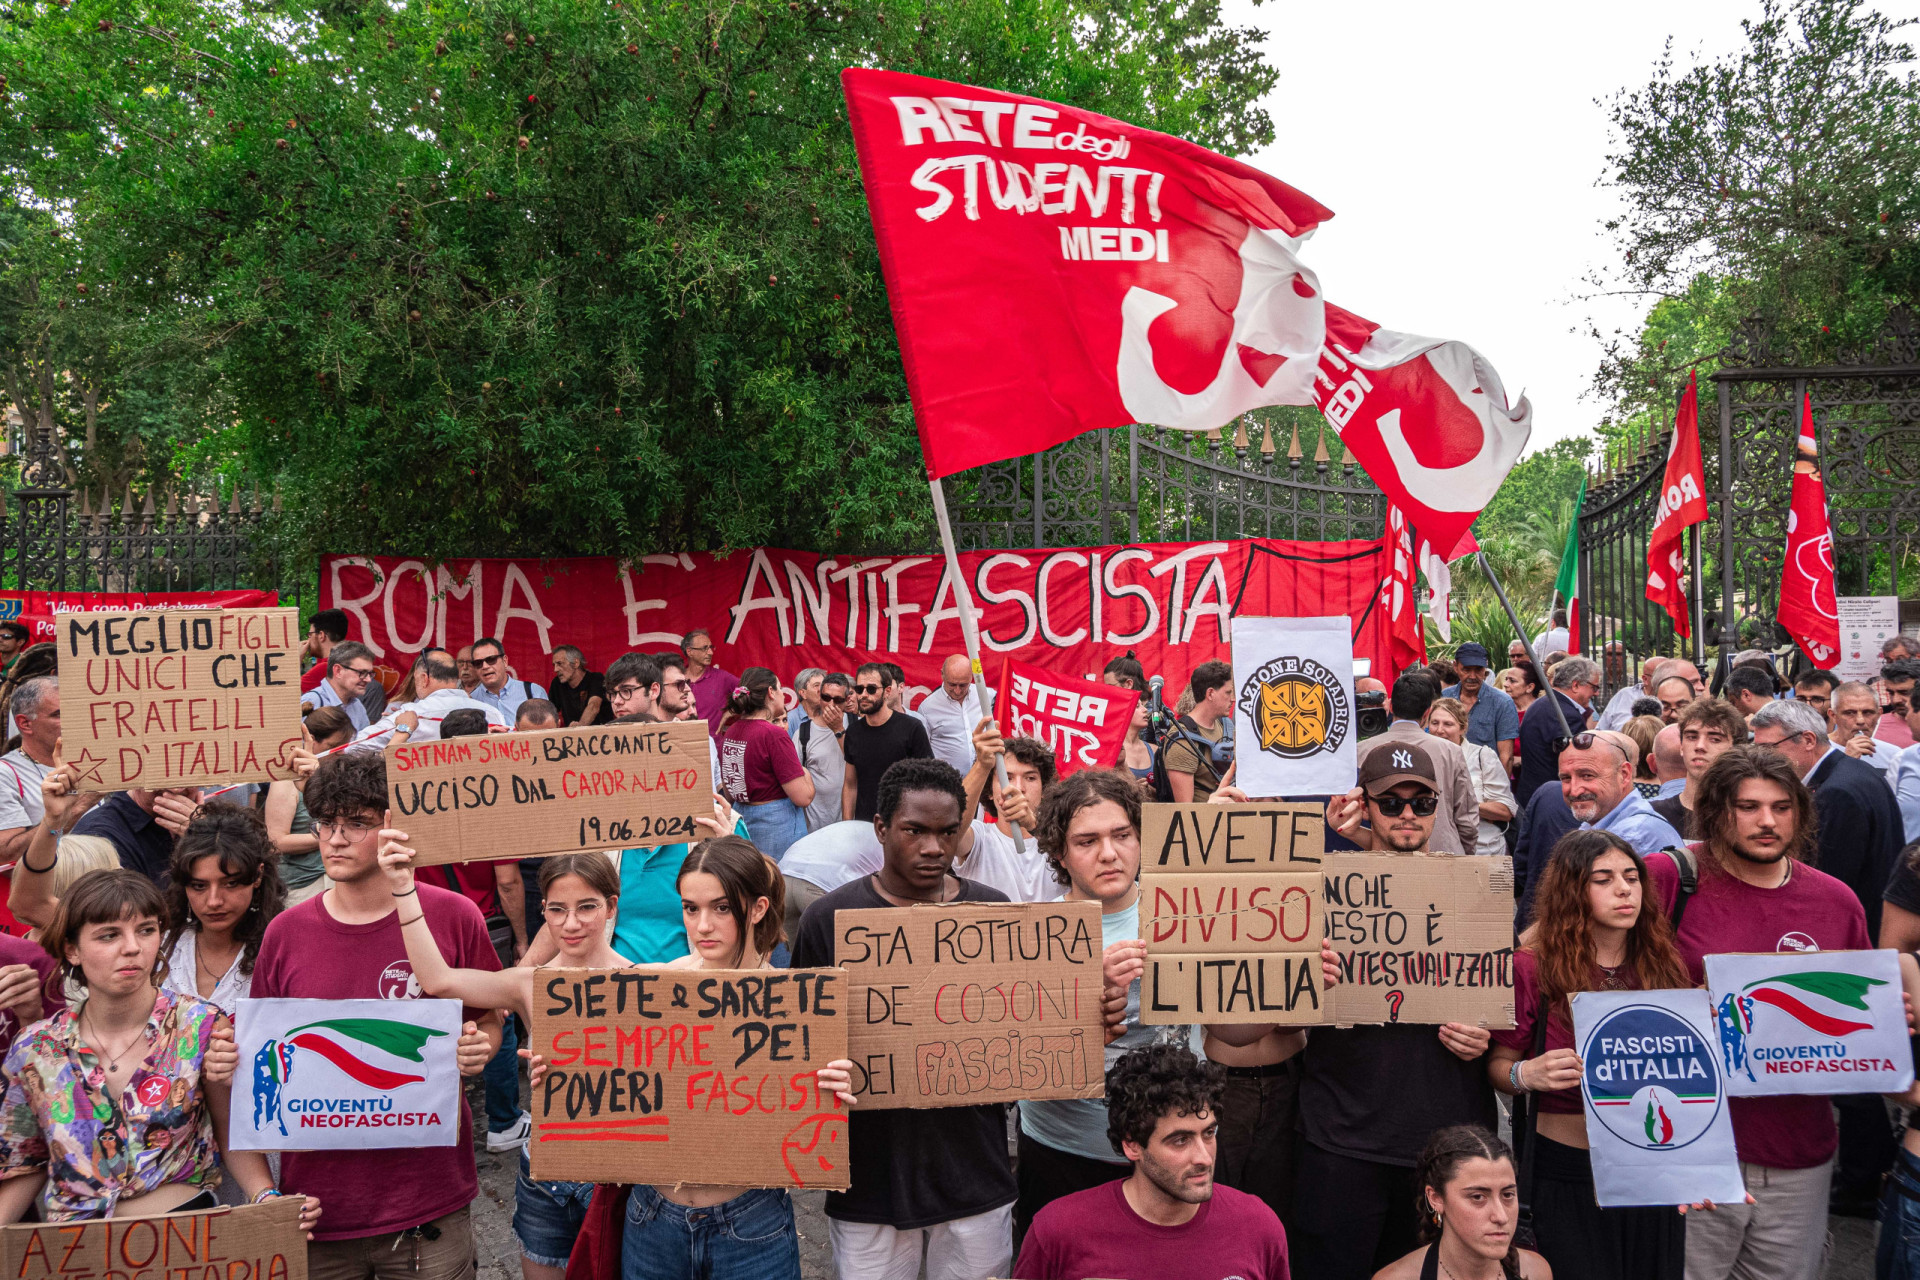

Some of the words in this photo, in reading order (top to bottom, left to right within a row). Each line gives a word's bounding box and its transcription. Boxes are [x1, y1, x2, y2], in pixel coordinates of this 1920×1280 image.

[889, 97, 1059, 148] RETE
[1053, 123, 1131, 160] degli
[910, 154, 1165, 225] STUDENTI
[1059, 226, 1169, 262] MEDI
[330, 557, 553, 658] ROMA
[725, 542, 1231, 653] ANTIFASCISTA
[69, 616, 213, 656] MEGLIO
[219, 615, 290, 650] FIGLI
[86, 655, 187, 695] UNICI
[212, 653, 286, 688] CHE
[89, 696, 265, 739] FRATELLI
[1240, 659, 1298, 715] AZIONE
[1303, 661, 1348, 752] SQUADRISTA
[120, 740, 261, 782] D'ITALIA
[395, 739, 472, 772] SATNAM
[480, 738, 538, 767] SINGH,
[543, 731, 672, 762] BRACCIANTE
[1392, 749, 1413, 768] NY
[513, 775, 555, 804] DAL
[562, 769, 698, 799] CAPORALATO
[579, 816, 697, 847] 19.06.2024
[1158, 811, 1323, 866] AVETE
[1322, 873, 1392, 908] NCHE
[1152, 886, 1311, 943] DIVISO
[1325, 910, 1407, 945] ESTO
[1426, 904, 1443, 946] È
[840, 926, 913, 968] STA
[934, 915, 1093, 965] ROTTURA
[546, 974, 662, 1020] SIETE
[698, 974, 837, 1019] SARETE
[866, 985, 913, 1025] DE
[936, 978, 1079, 1024] COJONI
[1151, 958, 1319, 1013] L'ITALIA
[1385, 990, 1404, 1023] ?
[551, 1025, 714, 1072] SEMPRE
[732, 1023, 809, 1069] DEI
[915, 1028, 1088, 1097] FASCISTI
[1600, 1035, 1694, 1055] FASCISTI
[1753, 1041, 1846, 1062] GIOVENTÙ
[1765, 1058, 1896, 1074] NEOFASCISTA
[1595, 1057, 1708, 1081] d’ITALIA
[287, 1095, 393, 1113] GIOVENTÙ
[543, 1070, 663, 1121] POVERI
[300, 1112, 441, 1128] NEOFASCISTA
[18, 1210, 231, 1278] AZIONE
